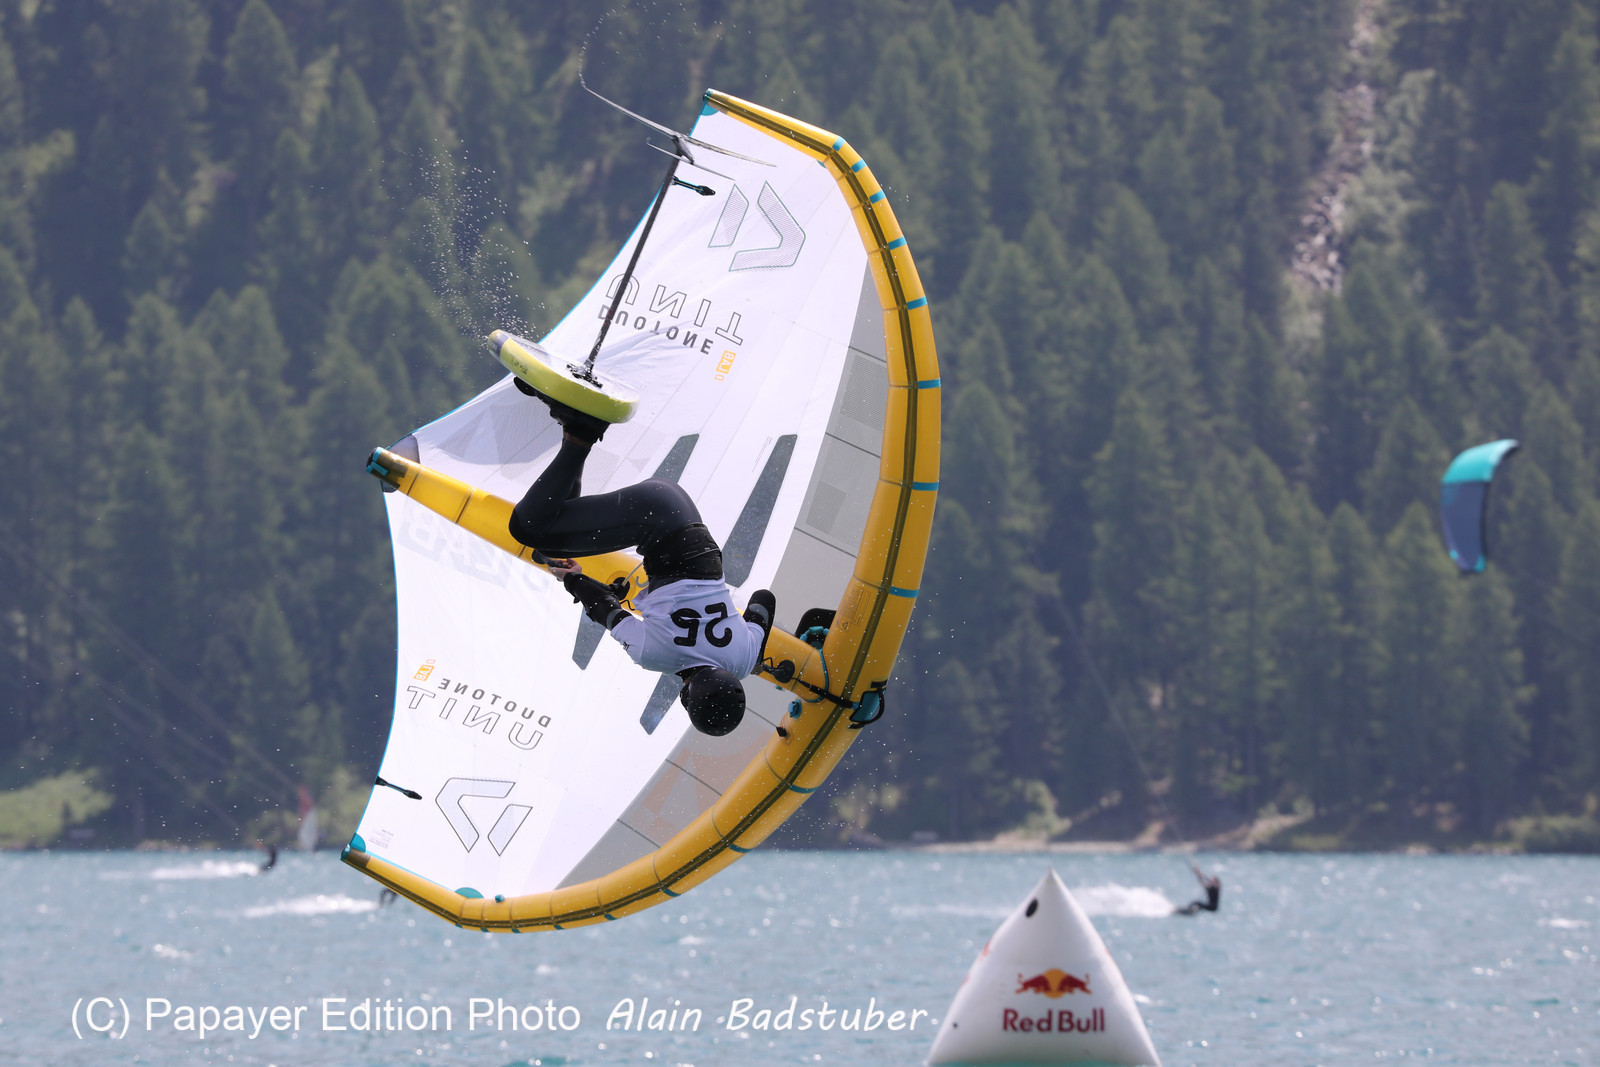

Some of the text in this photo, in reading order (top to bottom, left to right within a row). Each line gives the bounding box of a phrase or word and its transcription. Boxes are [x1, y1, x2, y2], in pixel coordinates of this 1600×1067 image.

[670, 602, 732, 648] 25
[1003, 1008, 1106, 1032] Red Bull
